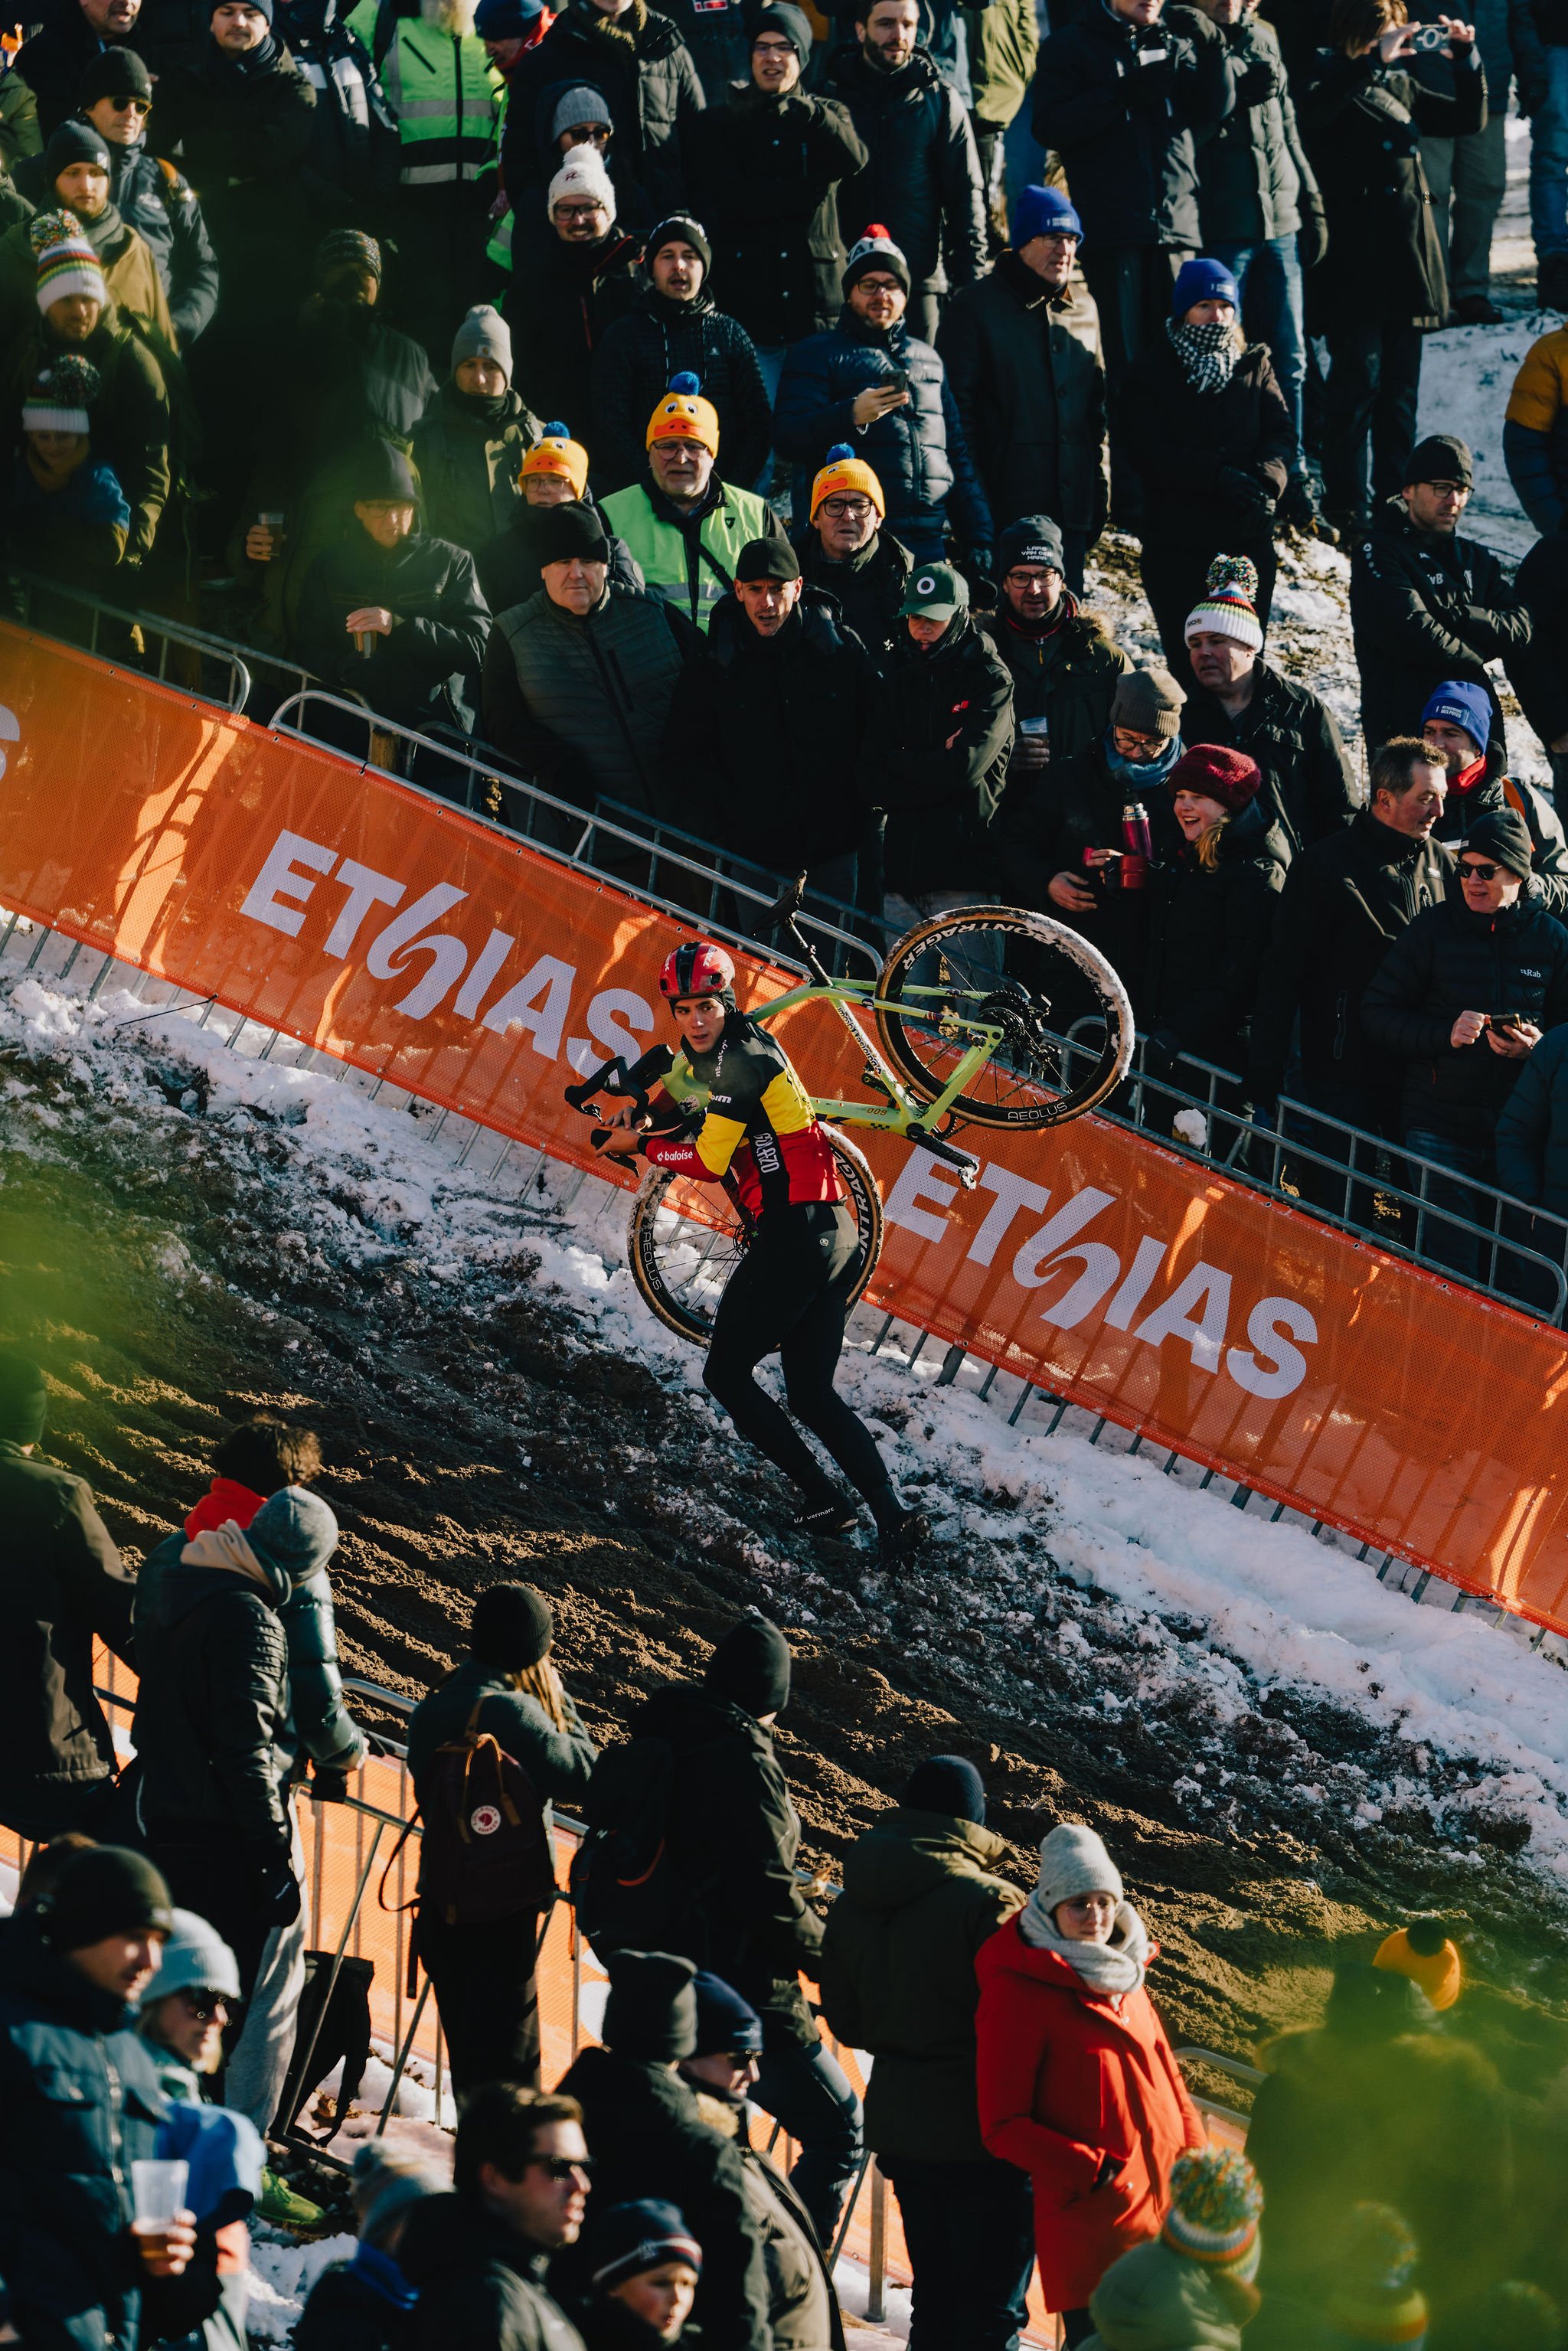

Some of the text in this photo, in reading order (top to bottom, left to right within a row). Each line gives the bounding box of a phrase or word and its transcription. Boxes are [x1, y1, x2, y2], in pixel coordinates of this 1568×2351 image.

[1427, 573, 1443, 585] vB
[1527, 968, 1541, 978] Rab
[1008, 1102, 1068, 1120] AEOLUS
[664, 1149, 694, 1161] baloise
[753, 1132, 780, 1174] GOLAZO
[643, 1232, 662, 1291] AEOLUS
[806, 1507, 835, 1520] vermarc
